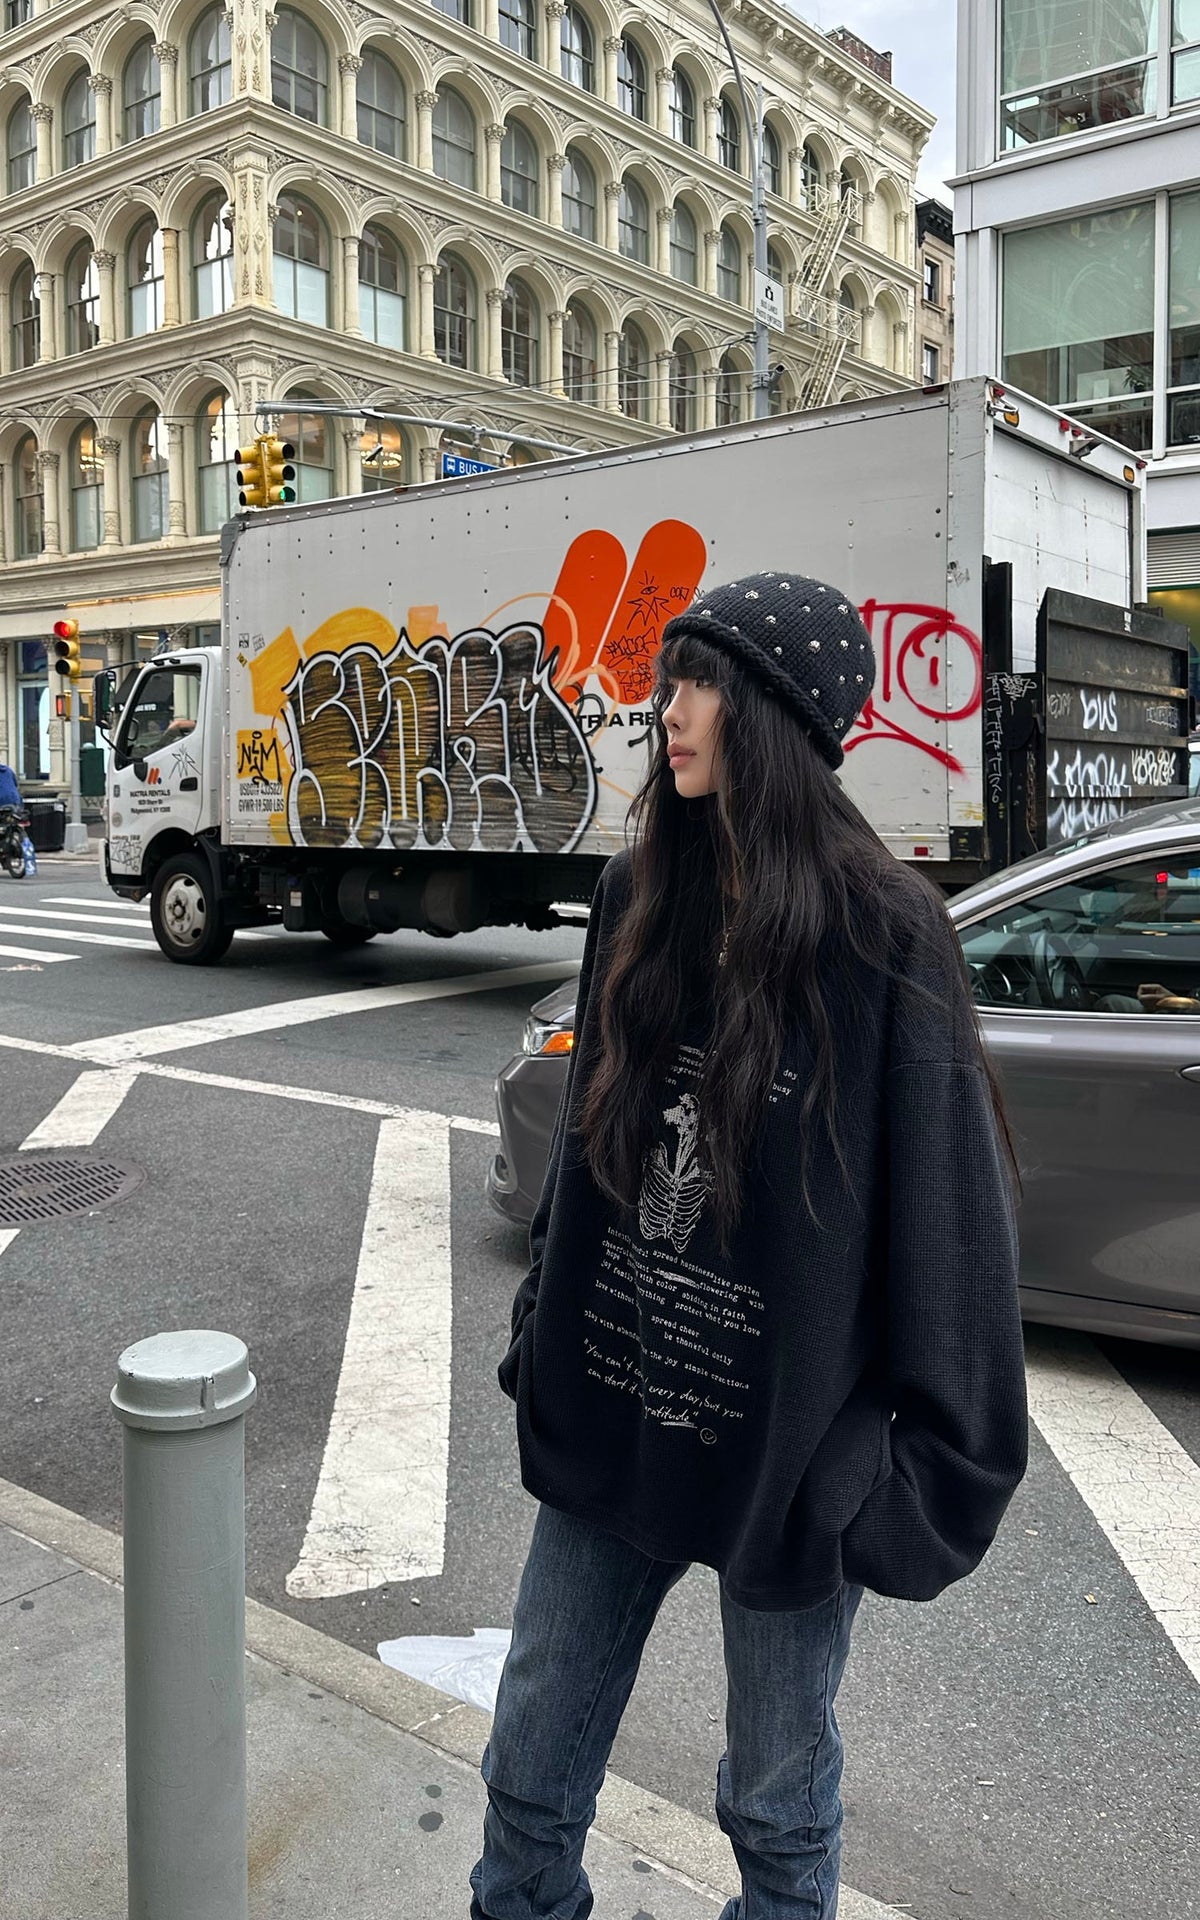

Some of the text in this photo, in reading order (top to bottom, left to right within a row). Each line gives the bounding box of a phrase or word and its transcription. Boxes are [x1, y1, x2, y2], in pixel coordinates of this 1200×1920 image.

[459, 461, 478, 475] BUS
[772, 1082, 792, 1096] busy
[782, 1069, 799, 1081] day
[652, 1249, 679, 1264] spread
[680, 1259, 714, 1280] happiness
[733, 1283, 760, 1298] pollen
[610, 1287, 635, 1305] without
[650, 1314, 678, 1330] spread
[679, 1323, 700, 1338] cheer
[656, 1280, 678, 1293] color
[710, 1303, 719, 1313] in
[722, 1307, 746, 1321] faith
[699, 1281, 739, 1303] flowering
[748, 1299, 765, 1312] with
[674, 1301, 703, 1318] protect
[723, 1319, 740, 1330] you
[742, 1323, 761, 1337] love
[600, 1318, 615, 1331] with
[649, 1350, 662, 1361] the
[663, 1355, 679, 1368] joy
[684, 1362, 709, 1378] simple
[663, 1330, 734, 1367] be thankful daily
[587, 1367, 602, 1381] can
[604, 1373, 629, 1390] start
[648, 1385, 676, 1400] every
[722, 1408, 744, 1420] you
